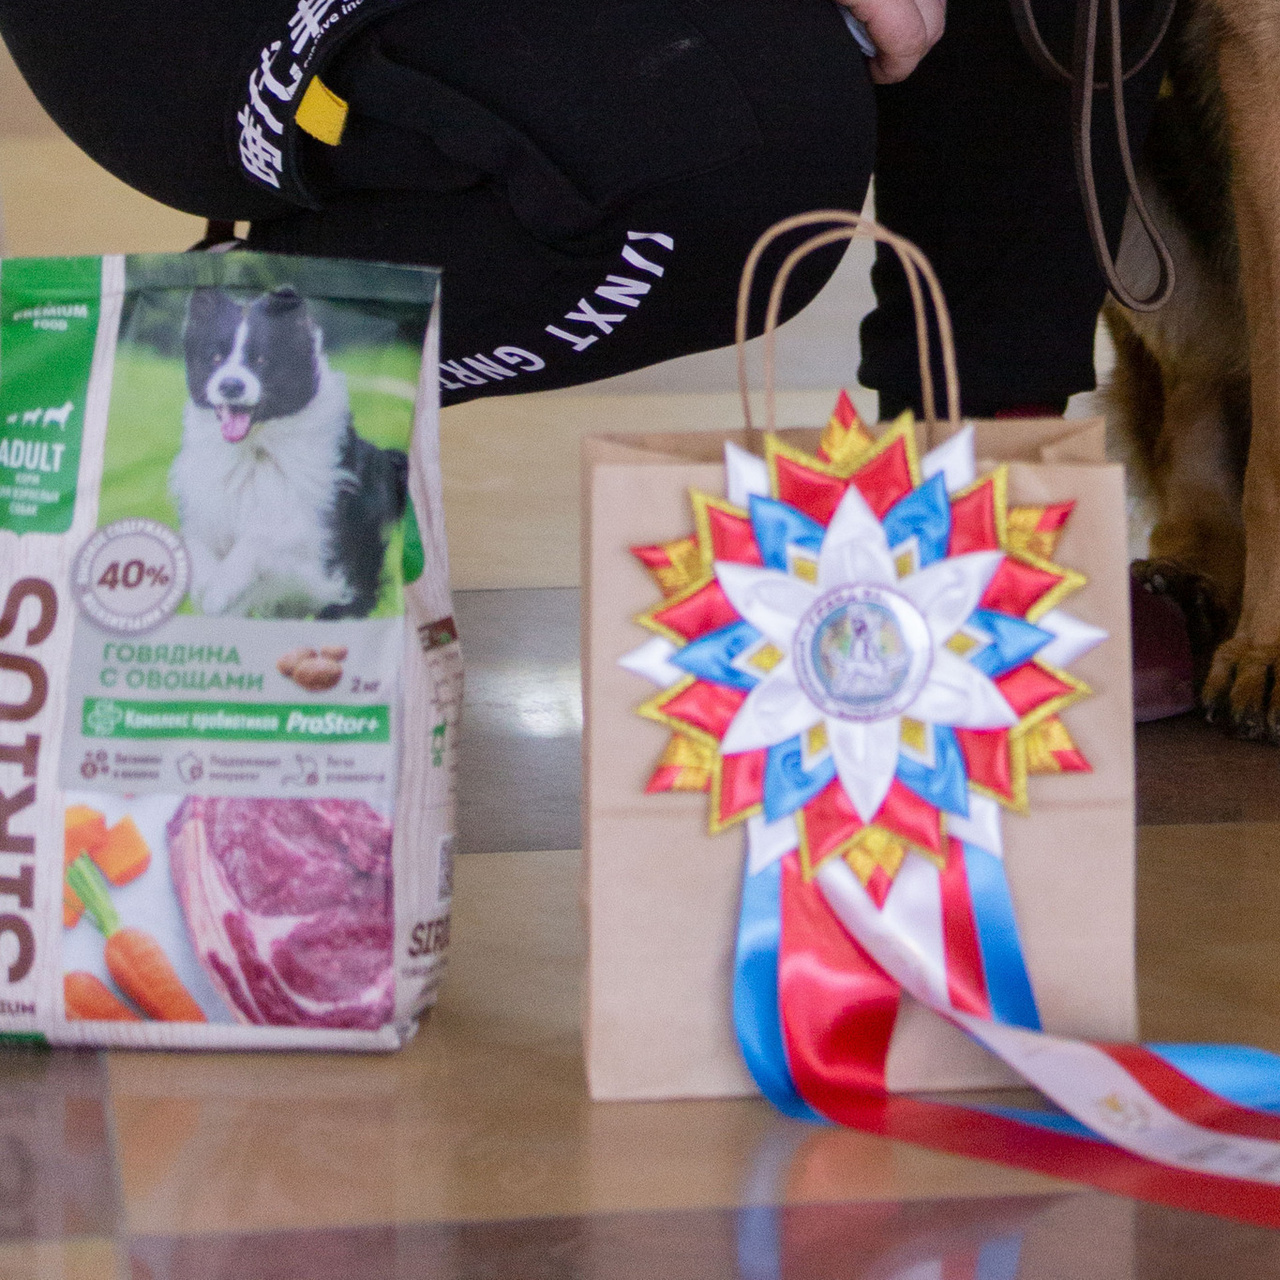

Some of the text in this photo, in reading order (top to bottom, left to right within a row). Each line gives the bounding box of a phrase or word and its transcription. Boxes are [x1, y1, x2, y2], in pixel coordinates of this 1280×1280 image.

[97, 559, 169, 591] 40%
[103, 642, 241, 665] ГОВЯДИНА
[100, 667, 264, 690] С ОВОЩАМИ
